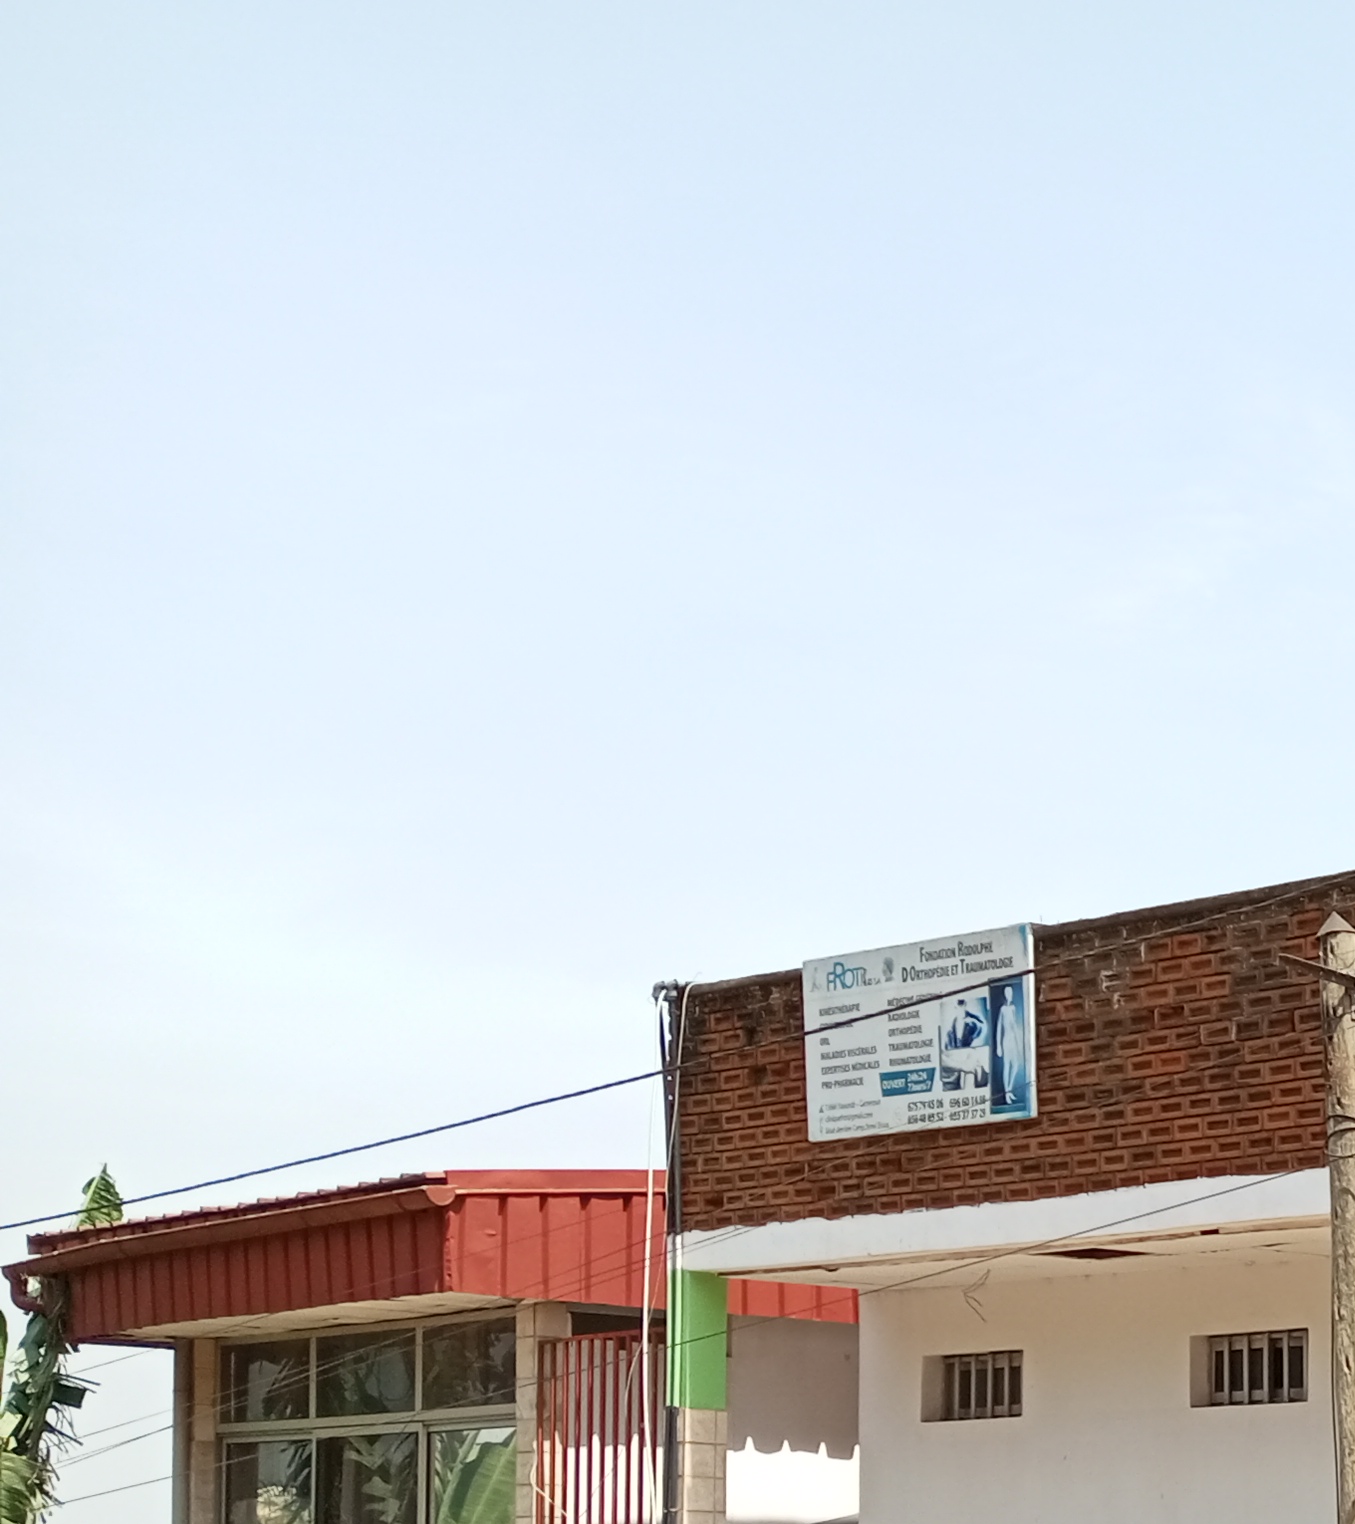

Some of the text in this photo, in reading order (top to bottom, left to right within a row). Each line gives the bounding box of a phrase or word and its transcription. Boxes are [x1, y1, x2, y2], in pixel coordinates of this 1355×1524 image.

[919, 941, 993, 963] FONDATION RODOLPHE
[960, 956, 1014, 974] TRAUMATOLOGIE
